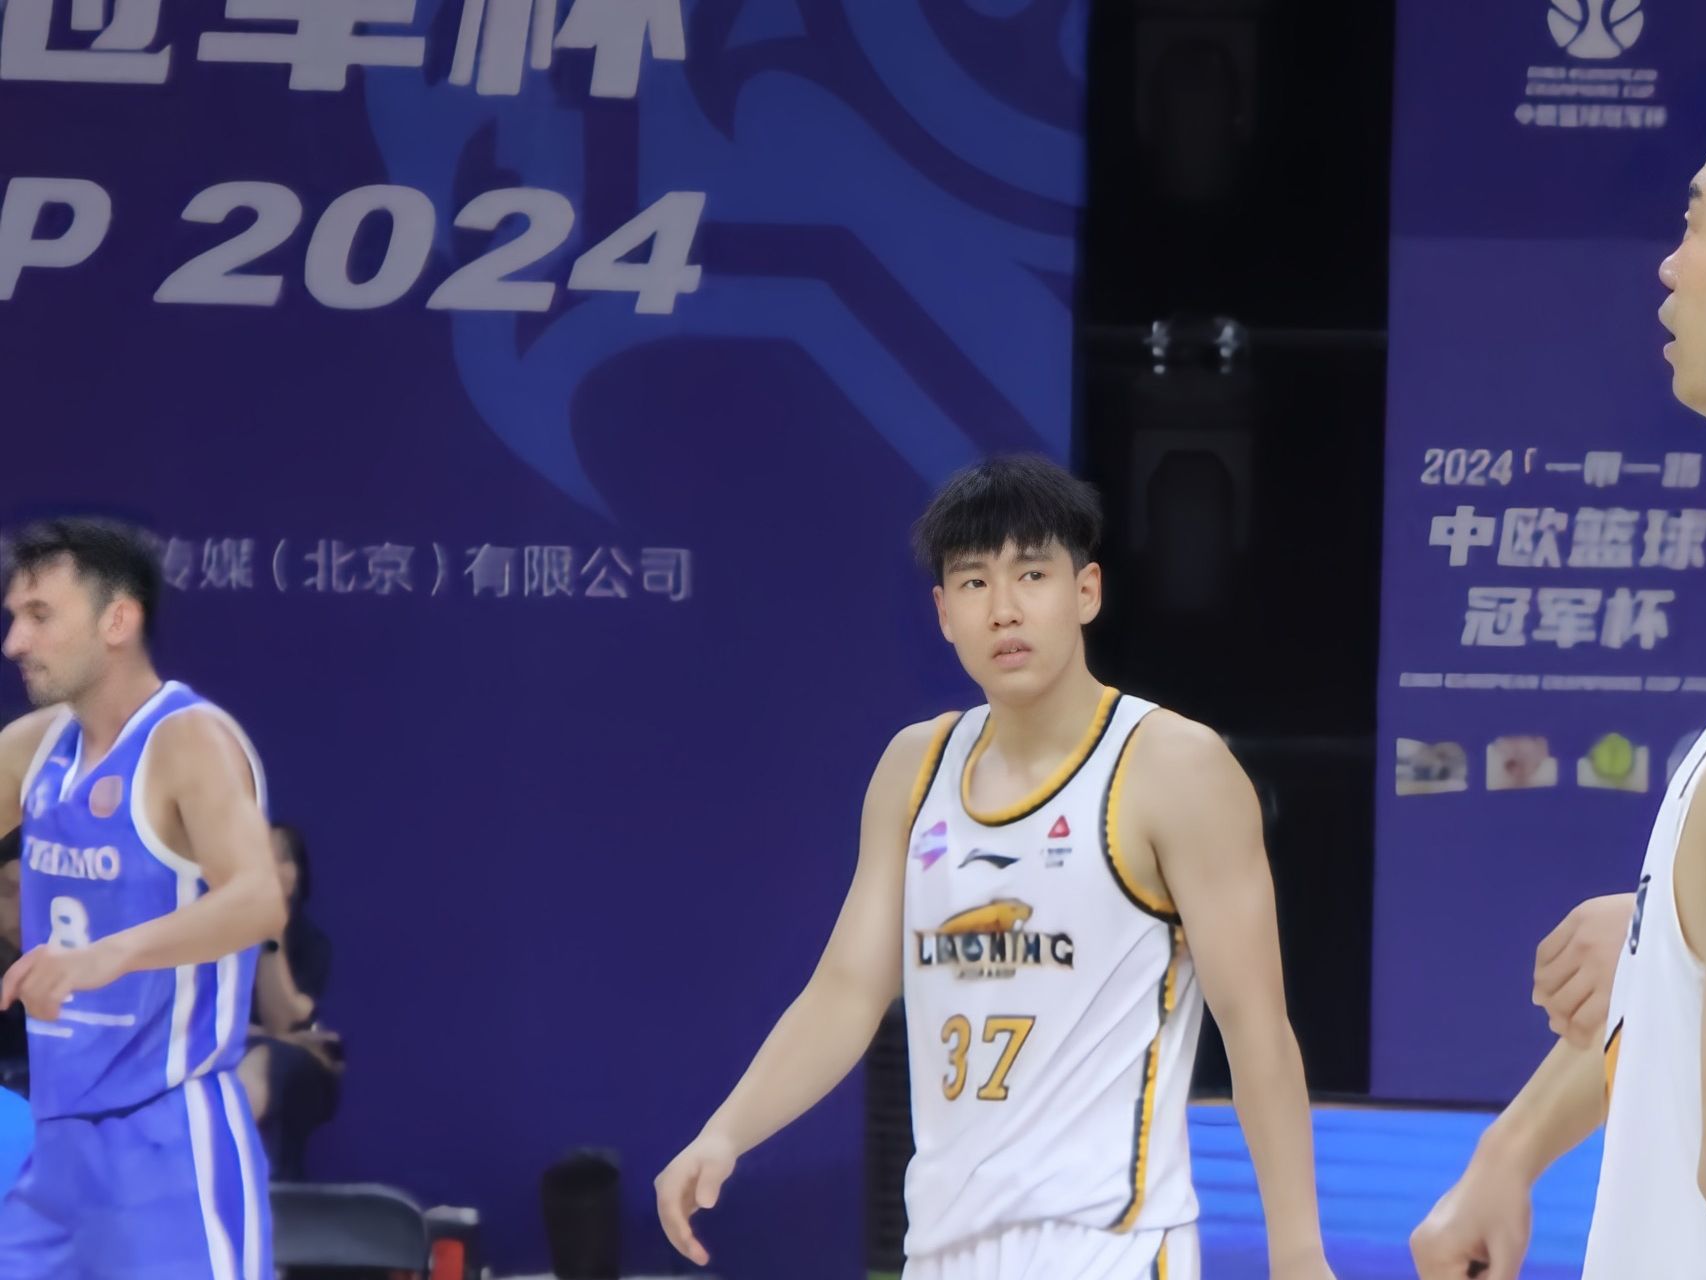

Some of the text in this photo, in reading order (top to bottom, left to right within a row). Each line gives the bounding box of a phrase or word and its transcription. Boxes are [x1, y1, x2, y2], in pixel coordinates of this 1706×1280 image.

[153, 180, 706, 315] 2024
[1460, 586, 1676, 650] 冠军杯
[940, 1012, 1037, 1101] 37
